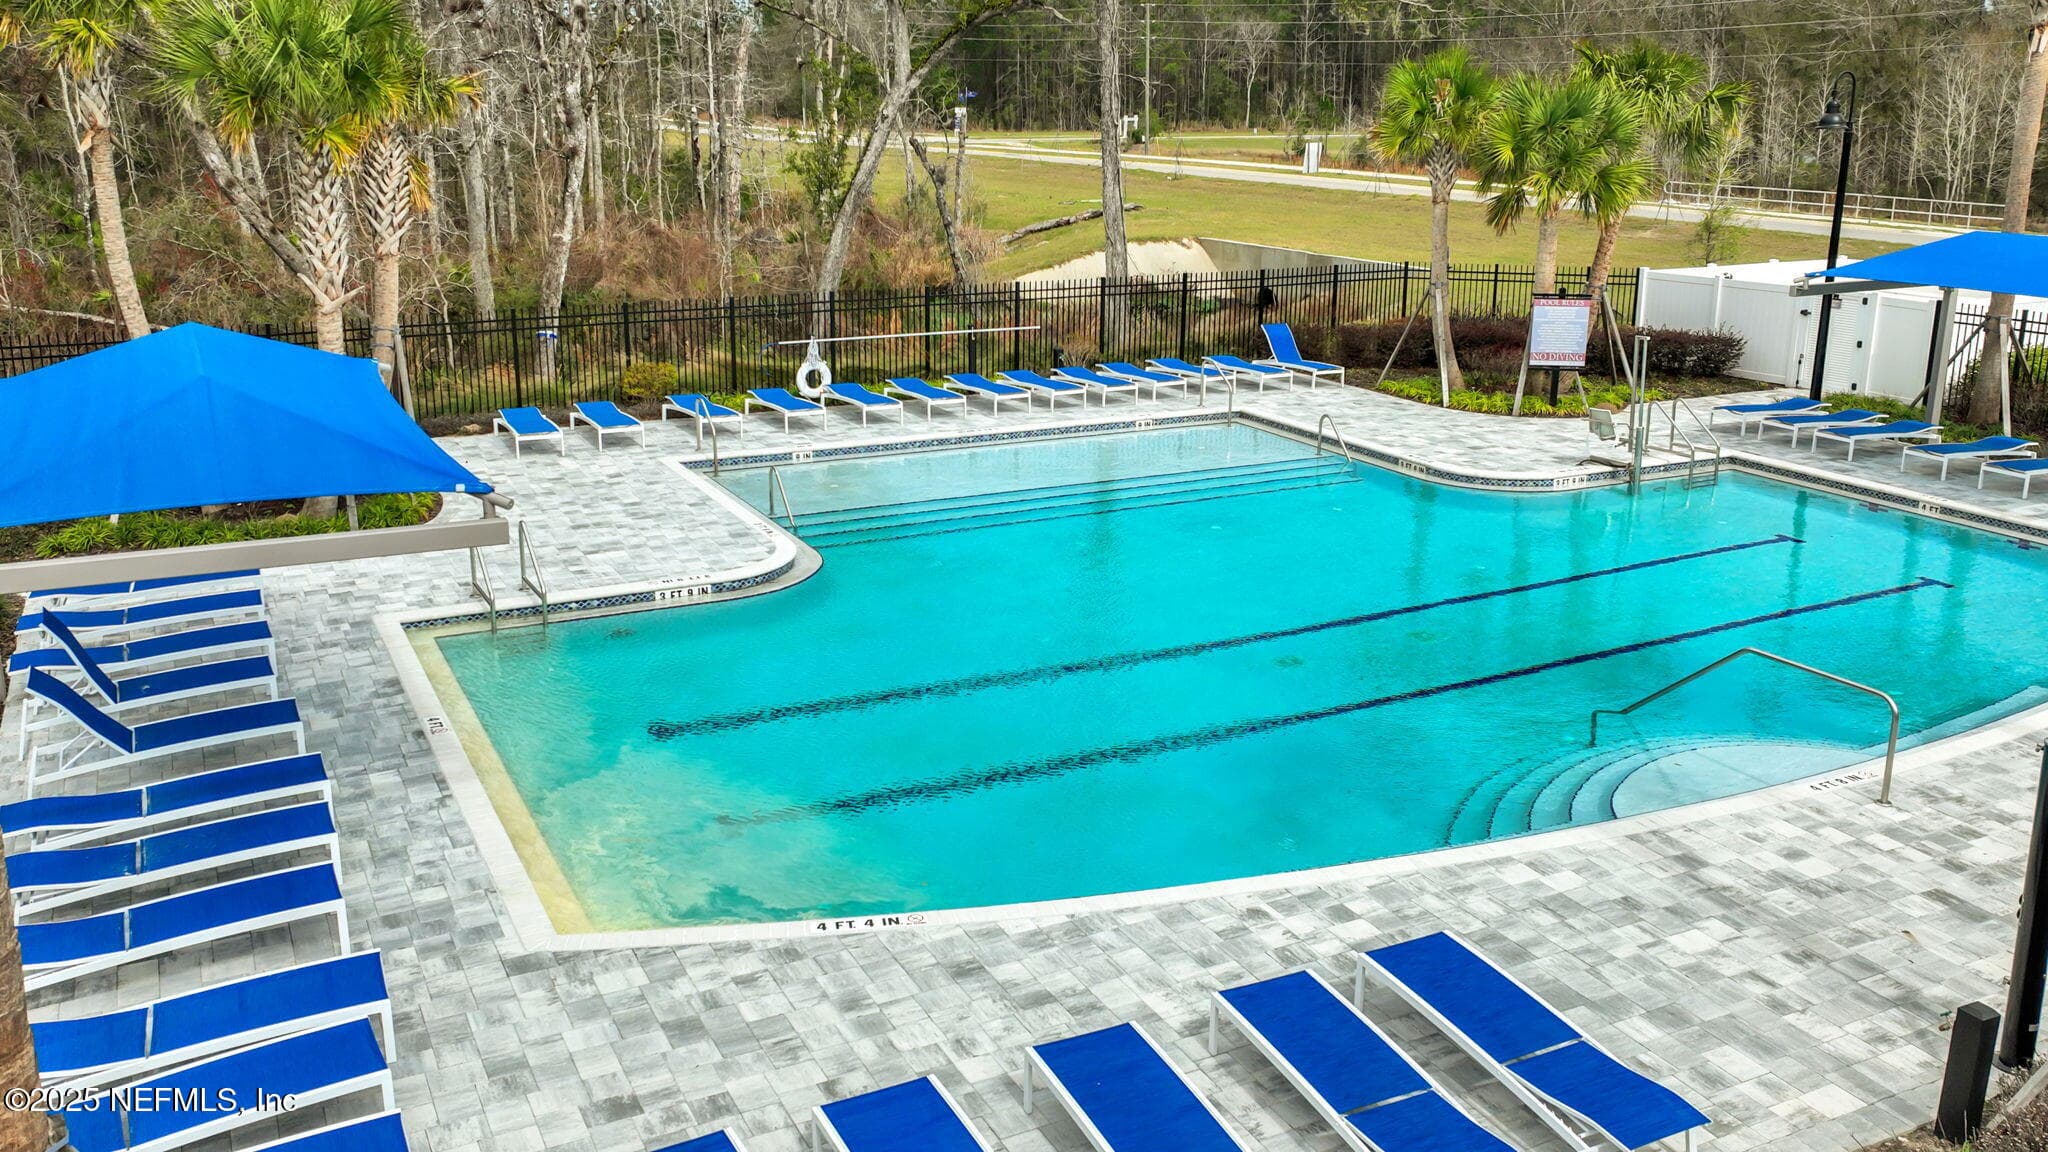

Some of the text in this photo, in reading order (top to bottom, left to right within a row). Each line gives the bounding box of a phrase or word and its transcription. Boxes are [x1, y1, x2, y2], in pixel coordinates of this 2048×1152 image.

[1549, 353, 1583, 361] DIVING
[659, 586, 709, 601] 3 FT 9 IN
[816, 922, 827, 931] 4
[864, 918, 874, 927] 4
